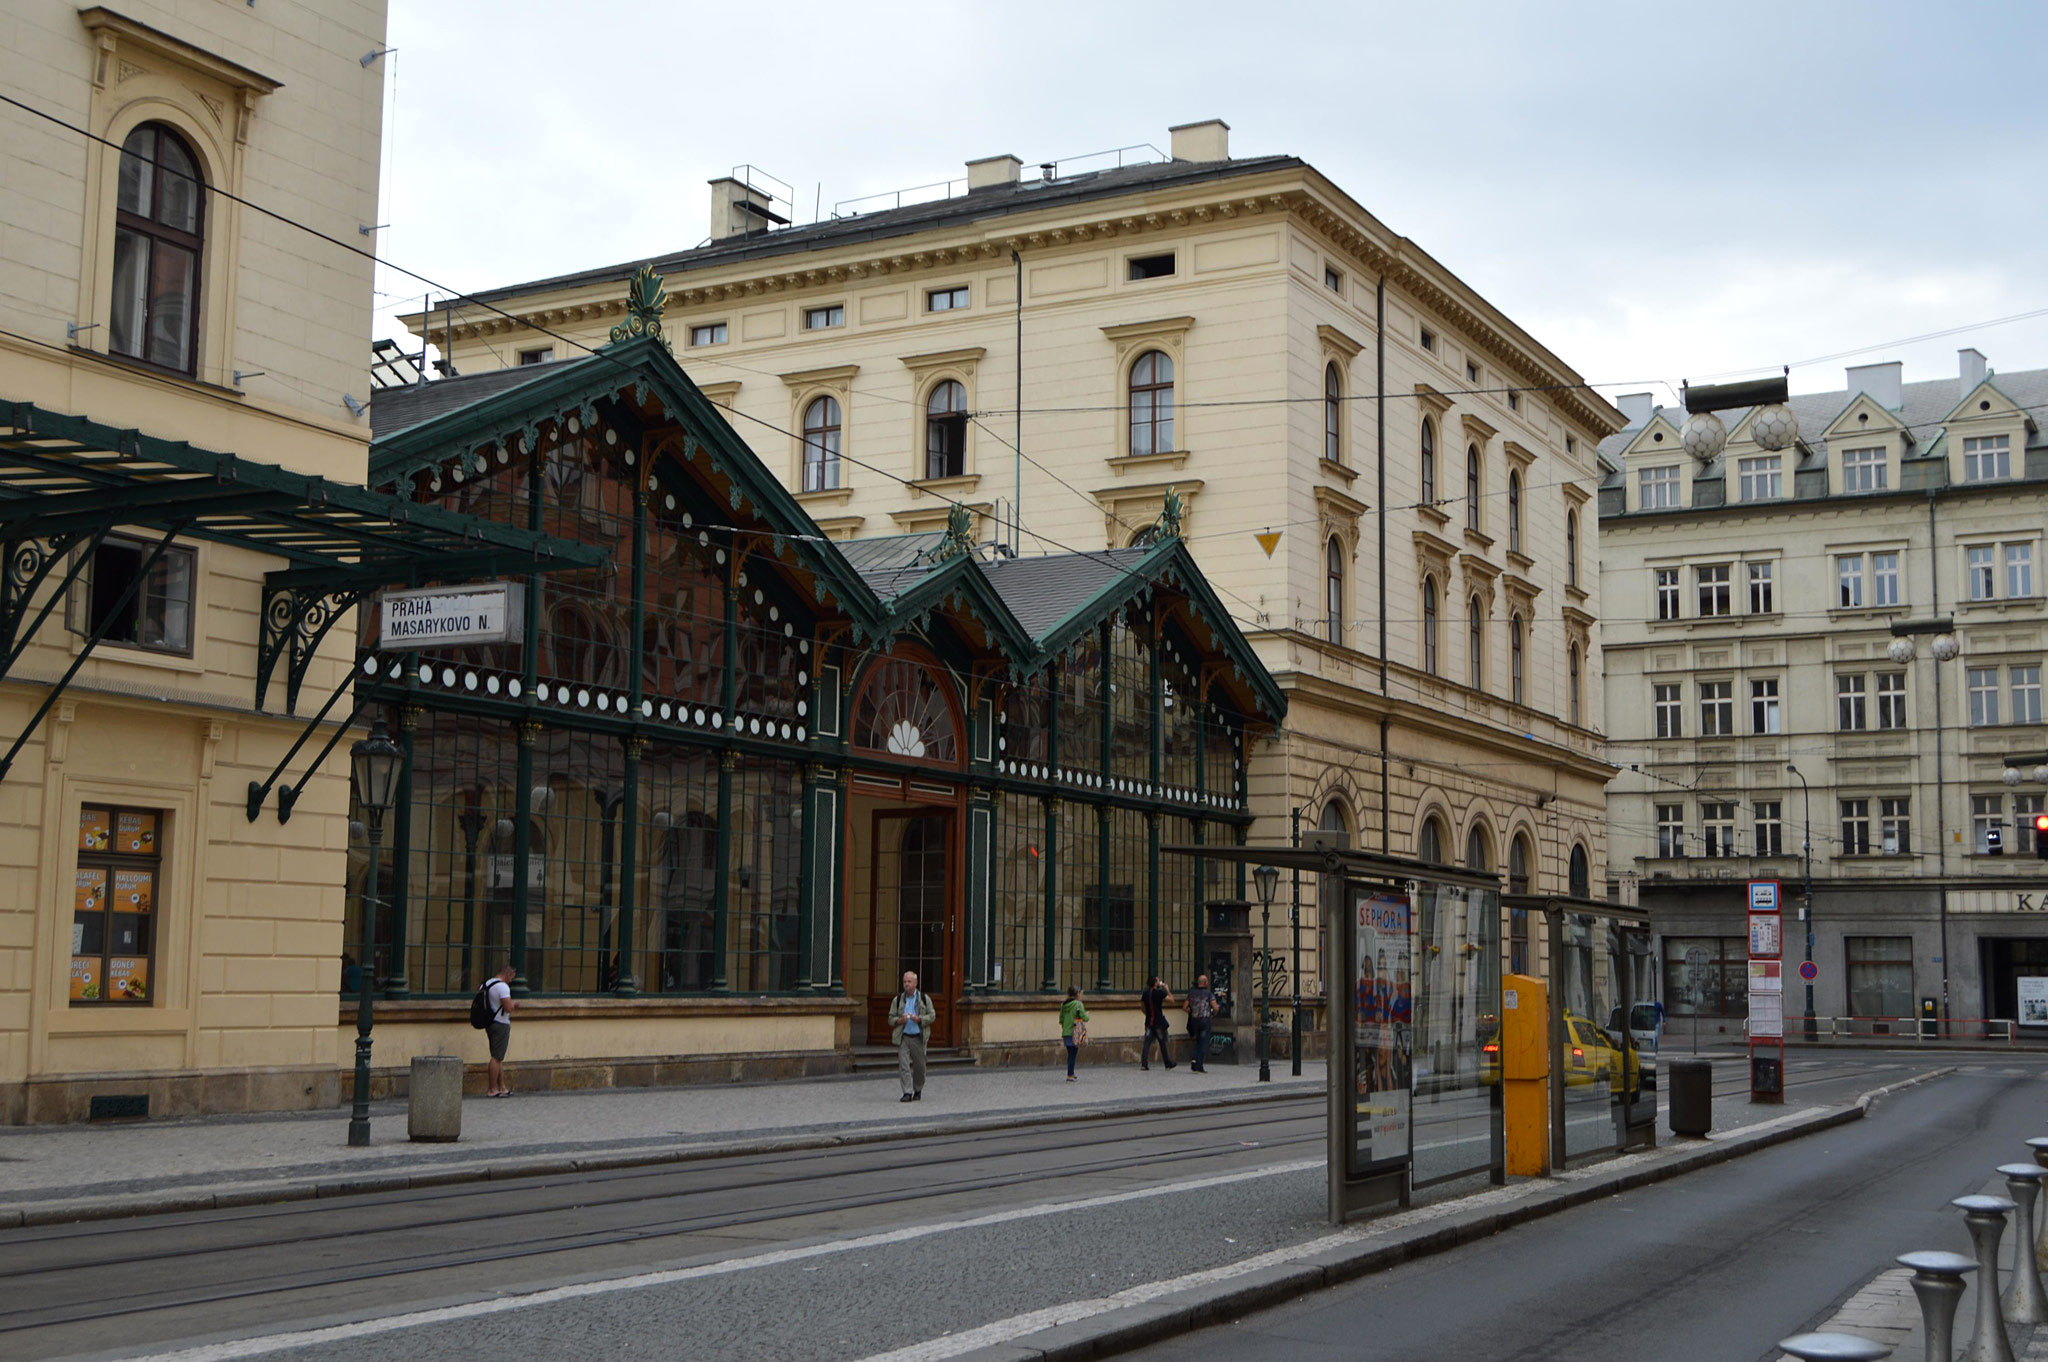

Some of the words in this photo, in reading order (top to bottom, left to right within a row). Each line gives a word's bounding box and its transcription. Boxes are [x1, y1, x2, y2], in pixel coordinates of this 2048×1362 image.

[392, 600, 432, 617] PRAHA
[391, 616, 470, 637] MASARYKOVO
[478, 615, 490, 630] N.
[115, 873, 152, 883] HALLOUMI
[1359, 908, 1402, 930] SEPHORA
